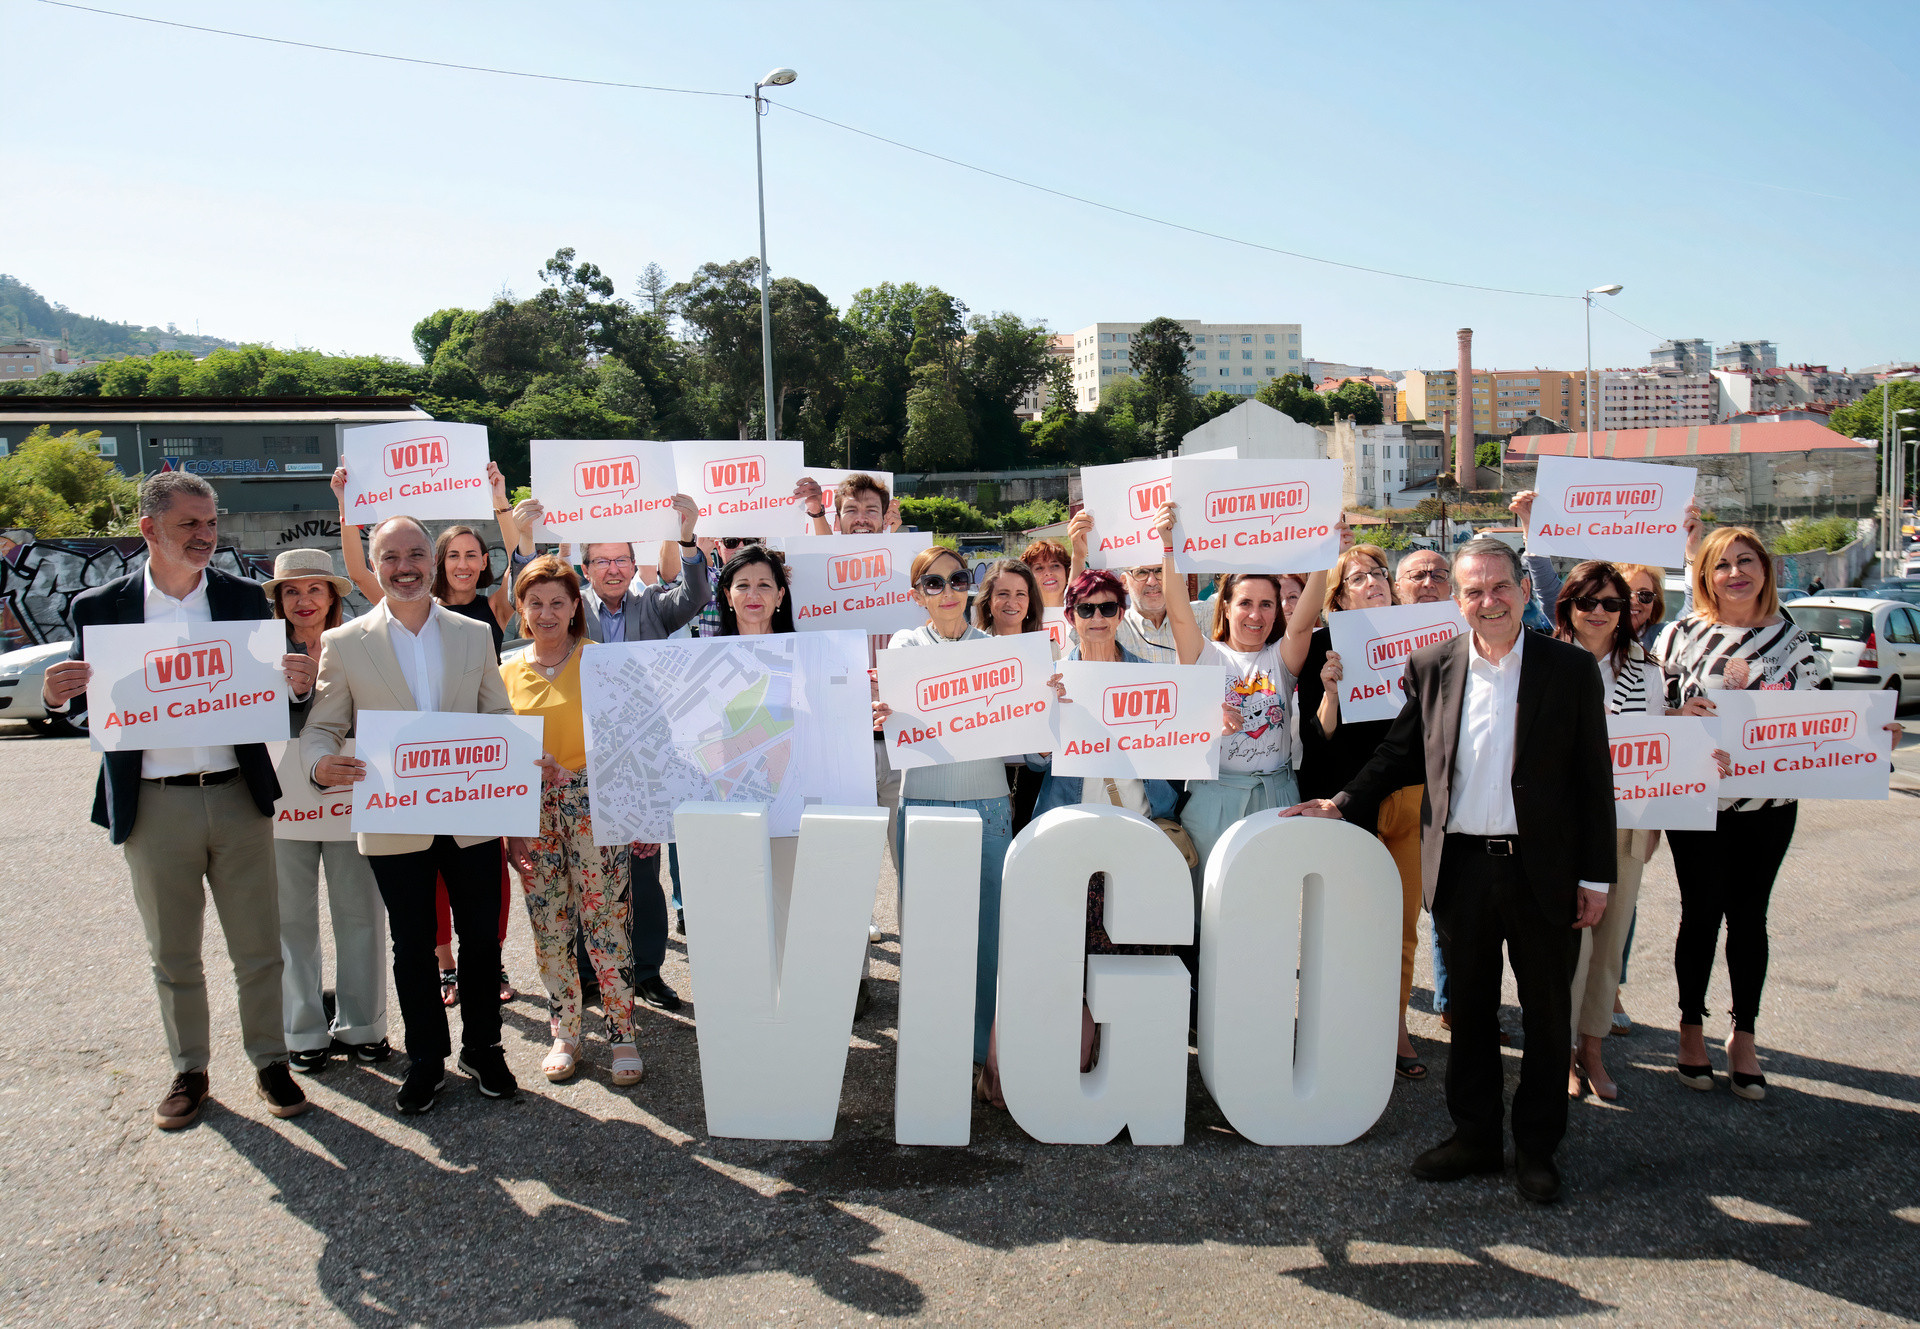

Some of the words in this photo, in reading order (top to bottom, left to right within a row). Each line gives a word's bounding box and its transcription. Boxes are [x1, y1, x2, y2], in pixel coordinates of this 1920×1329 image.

[391, 442, 444, 470] VOTA
[581, 462, 635, 490] VOTA
[710, 461, 760, 487] VOTA
[355, 487, 392, 507] Abel
[400, 477, 482, 497] Caballero
[1136, 483, 1171, 512] VO
[1212, 494, 1255, 517] ¡VOTA
[1260, 488, 1303, 510] VIGO!
[1571, 490, 1611, 507] ¡VOTA
[1616, 489, 1656, 505] VIGO!
[543, 507, 583, 525] Abel
[590, 497, 671, 518] Caballero
[698, 504, 712, 517] el
[718, 496, 795, 514] Caballero
[1099, 531, 1141, 551] Abel
[1183, 534, 1227, 553] Abel
[1234, 525, 1329, 546] Caballero
[1539, 522, 1581, 537] Abel
[1588, 521, 1677, 536] Caballero
[835, 555, 886, 582] VOTA
[798, 600, 836, 620] Abel
[842, 591, 911, 612] Caballer
[155, 648, 225, 683] VOTA
[1373, 639, 1412, 664] ¡VOTA
[923, 681, 968, 706] ¡VOTA
[972, 666, 1016, 691] VIGO!
[1349, 680, 1390, 702] Abel
[104, 706, 158, 730] Abel
[167, 689, 276, 719] Caballero
[1112, 688, 1170, 718] VOTA
[896, 721, 942, 748] Abel
[949, 699, 1047, 734] Caballero
[1750, 724, 1797, 743] ¡VOTA
[1802, 717, 1848, 736] VIGO!
[1064, 738, 1110, 757] Abel
[1118, 730, 1211, 751] Caballero
[402, 749, 450, 772] ¡VOTA
[455, 744, 501, 765] VIGO!
[1734, 760, 1766, 777] bel
[1773, 752, 1877, 773] Caballero
[365, 791, 418, 810] Abel
[426, 783, 529, 804] Caballero
[278, 805, 324, 822] Abel
[673, 804, 1404, 1147] VIGO
